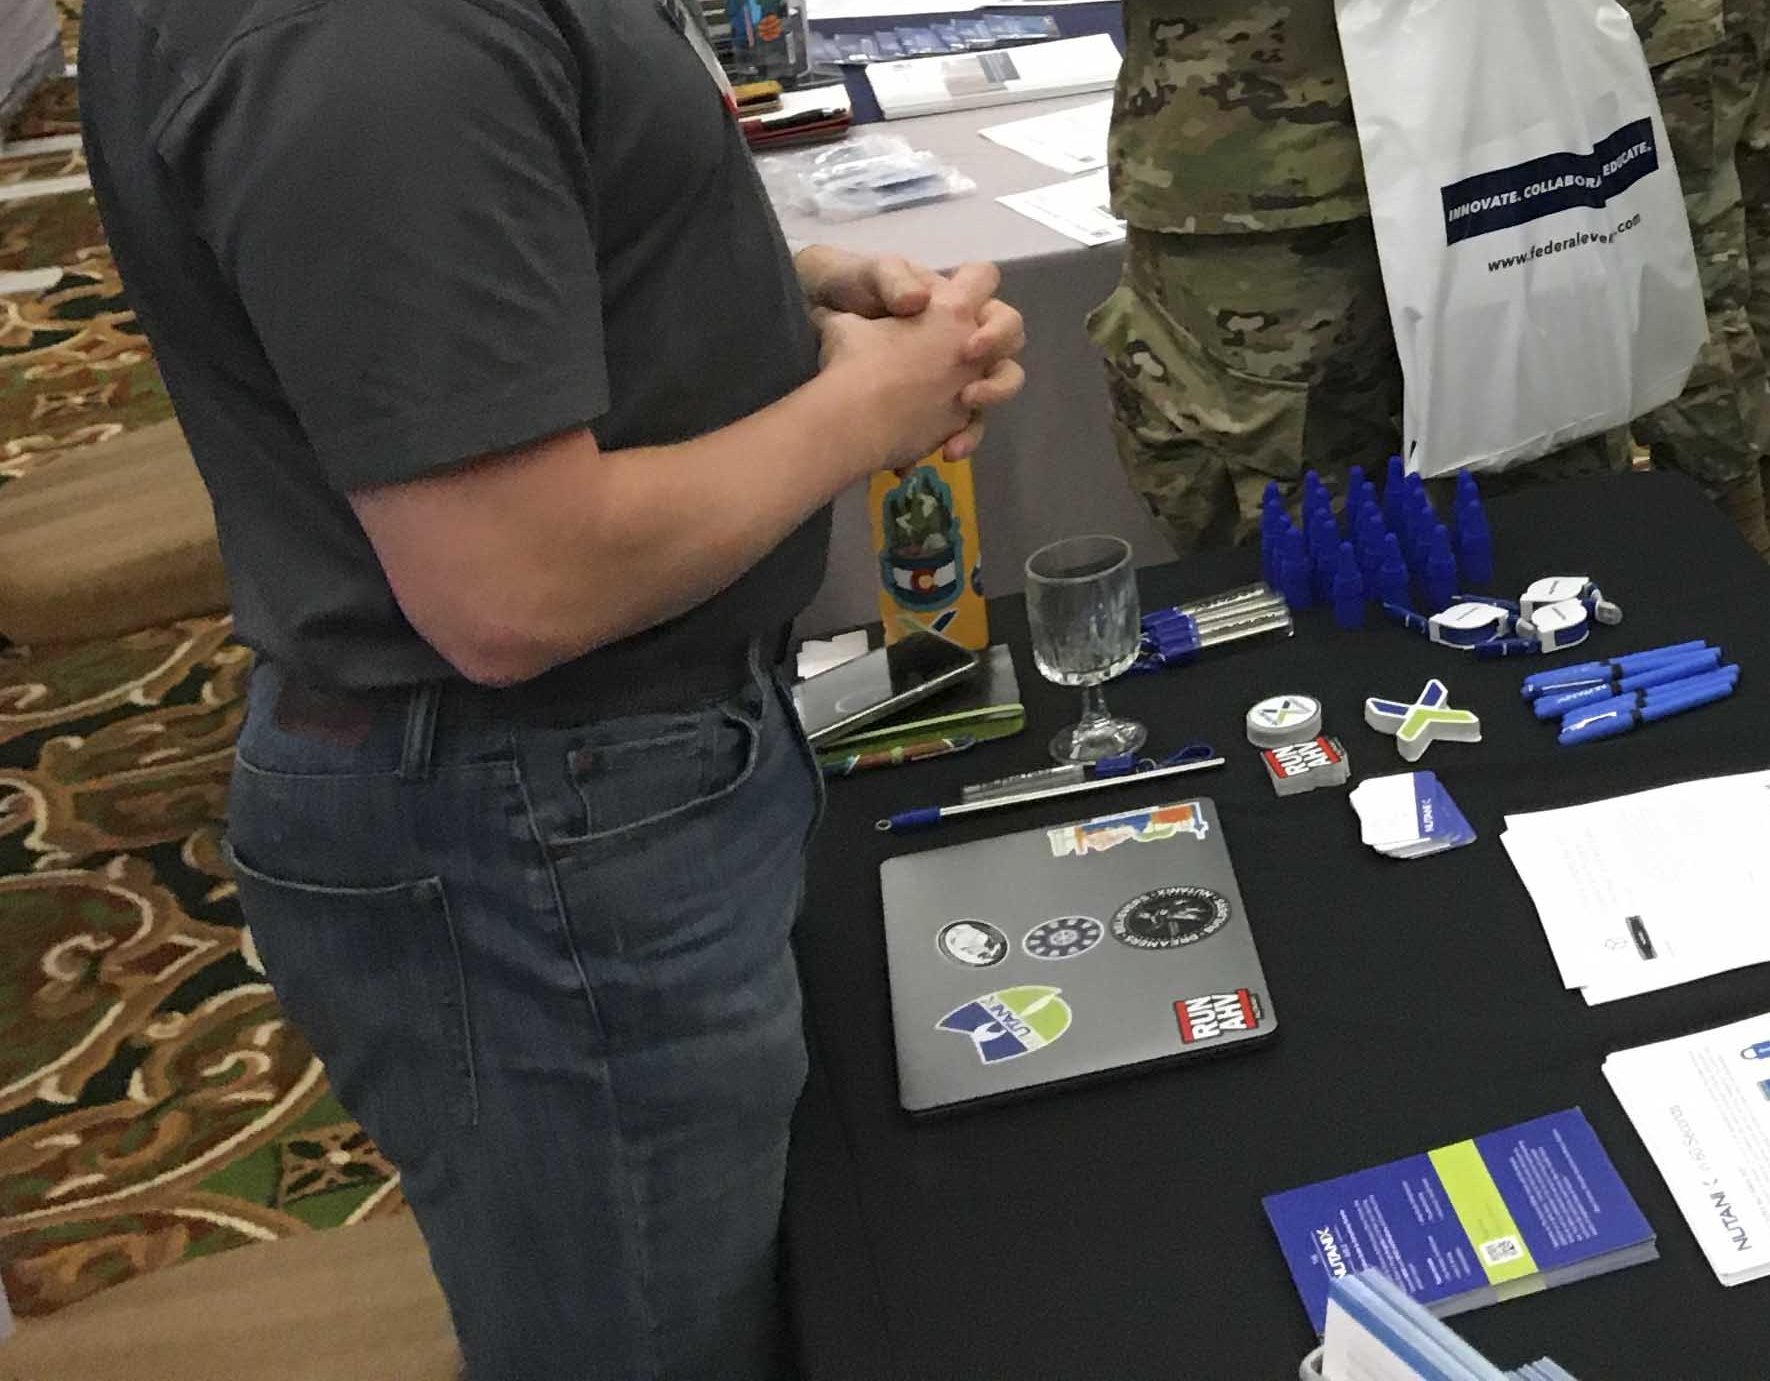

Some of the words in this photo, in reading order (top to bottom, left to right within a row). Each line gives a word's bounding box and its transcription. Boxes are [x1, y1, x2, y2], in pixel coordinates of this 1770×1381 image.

[1271, 744, 1310, 776] RUN
[1293, 741, 1333, 768] AHV
[1185, 995, 1220, 1040] RUN
[1211, 994, 1248, 1029] AHV
